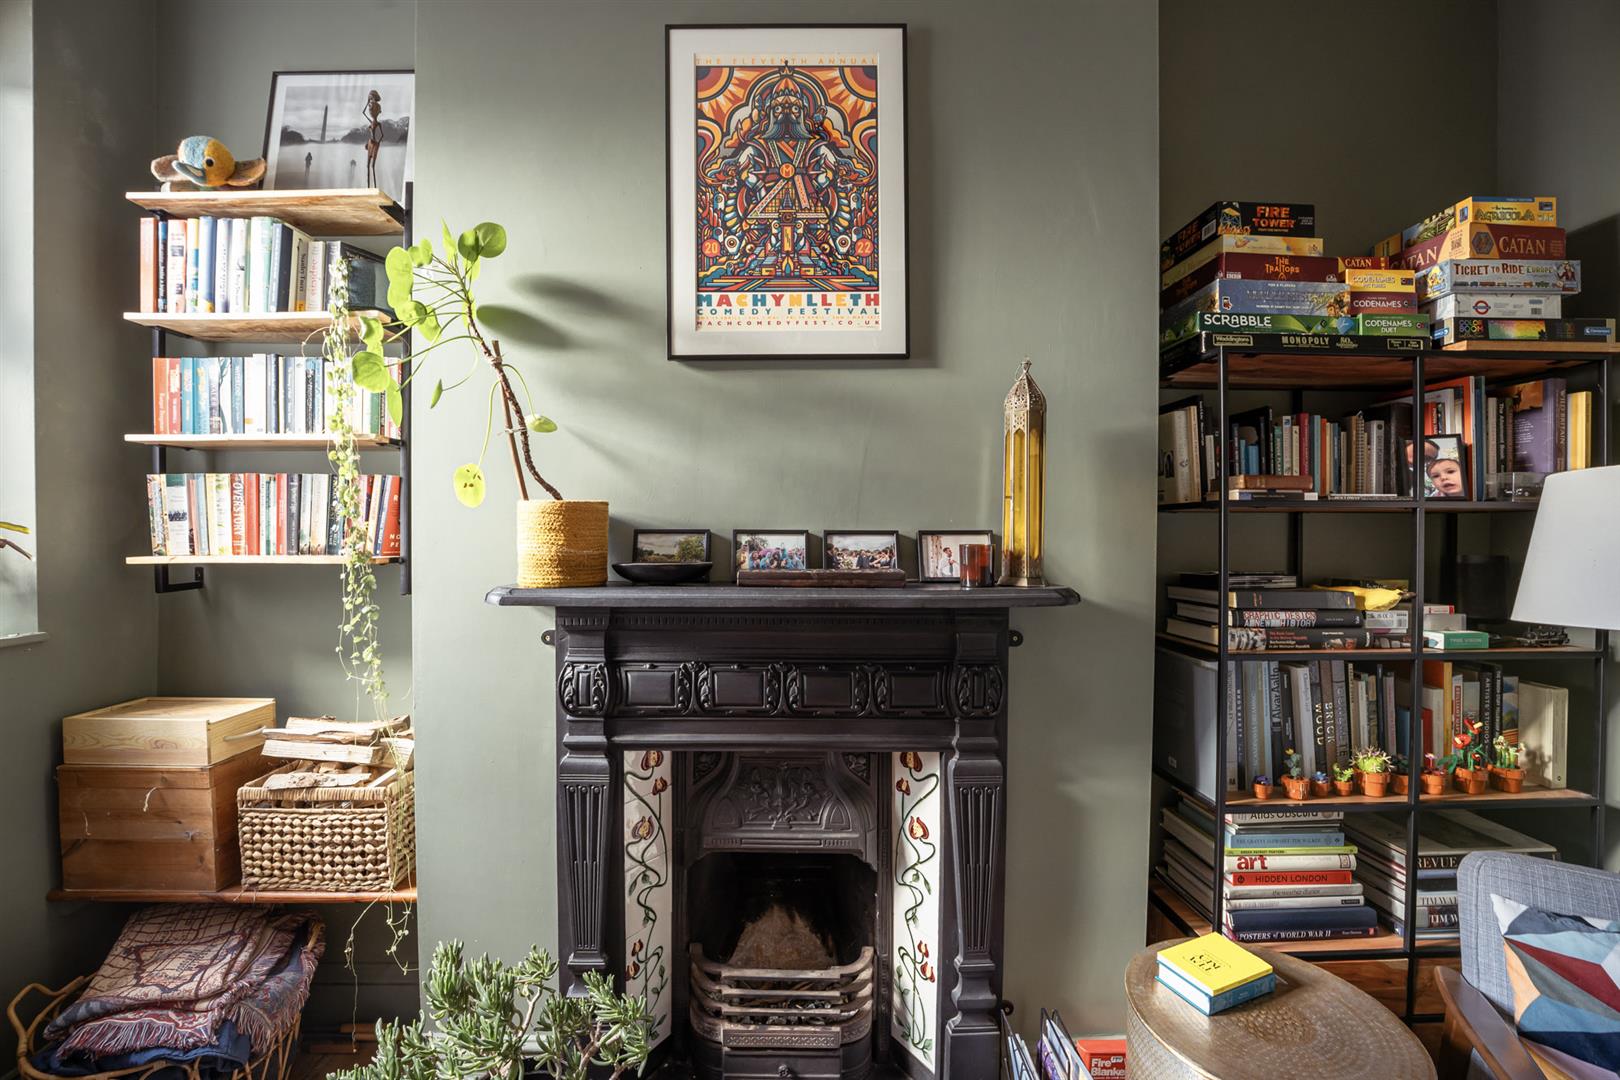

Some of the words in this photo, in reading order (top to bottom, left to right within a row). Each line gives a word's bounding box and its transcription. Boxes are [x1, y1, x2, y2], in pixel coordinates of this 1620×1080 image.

[696, 57, 721, 65] THE
[733, 57, 807, 65] ELEVENTH
[818, 57, 877, 65] ANNUAL
[1256, 206, 1290, 218] FIRE
[1475, 208, 1535, 222] AGRICOLA
[1252, 218, 1297, 229] TOWER
[705, 242, 718, 254] 20
[858, 242, 872, 254] 22
[1500, 236, 1545, 255] CATAN
[1275, 256, 1290, 265] THE
[1344, 258, 1372, 268] CATAN
[1265, 263, 1300, 274] TRAITORS
[1453, 263, 1489, 276] TICKET
[1491, 266, 1501, 274] TO
[1502, 263, 1524, 275] RIDE
[310, 256, 319, 297] Sapiens
[1352, 275, 1396, 284] CODENAMES
[696, 294, 880, 307] MACHYNLLETH
[1353, 300, 1402, 308] CODENAMES
[696, 308, 772, 316] COMEDY
[788, 308, 880, 316] FESTIVAL
[1204, 313, 1272, 328] SCRABBLE
[1364, 319, 1413, 328] CODENAMES
[1281, 335, 1330, 345] MONOPOLY
[1559, 413, 1567, 447] BRITAIN
[232, 482, 245, 537] OVERSTORY
[1280, 619, 1317, 628] HISTORY
[1270, 667, 1280, 693] Aalto
[1271, 693, 1281, 720] Alvar
[1315, 703, 1325, 746] WOOD
[1325, 702, 1335, 744] BRICK
[1250, 811, 1275, 820] Atlas
[1276, 811, 1319, 819] Obscura
[1236, 854, 1268, 870] art
[1416, 856, 1458, 869] REVUE
[1255, 875, 1288, 883] HIDDEN
[1290, 874, 1329, 883] LONDON
[1421, 896, 1435, 906] TIM
[1429, 913, 1450, 925] TIM
[1239, 931, 1272, 941] POSTERS
[1280, 930, 1307, 939] WORLD
[1307, 930, 1325, 938] WAR
[1091, 1057, 1112, 1068] Fire
[1090, 1067, 1125, 1077] Blanke
